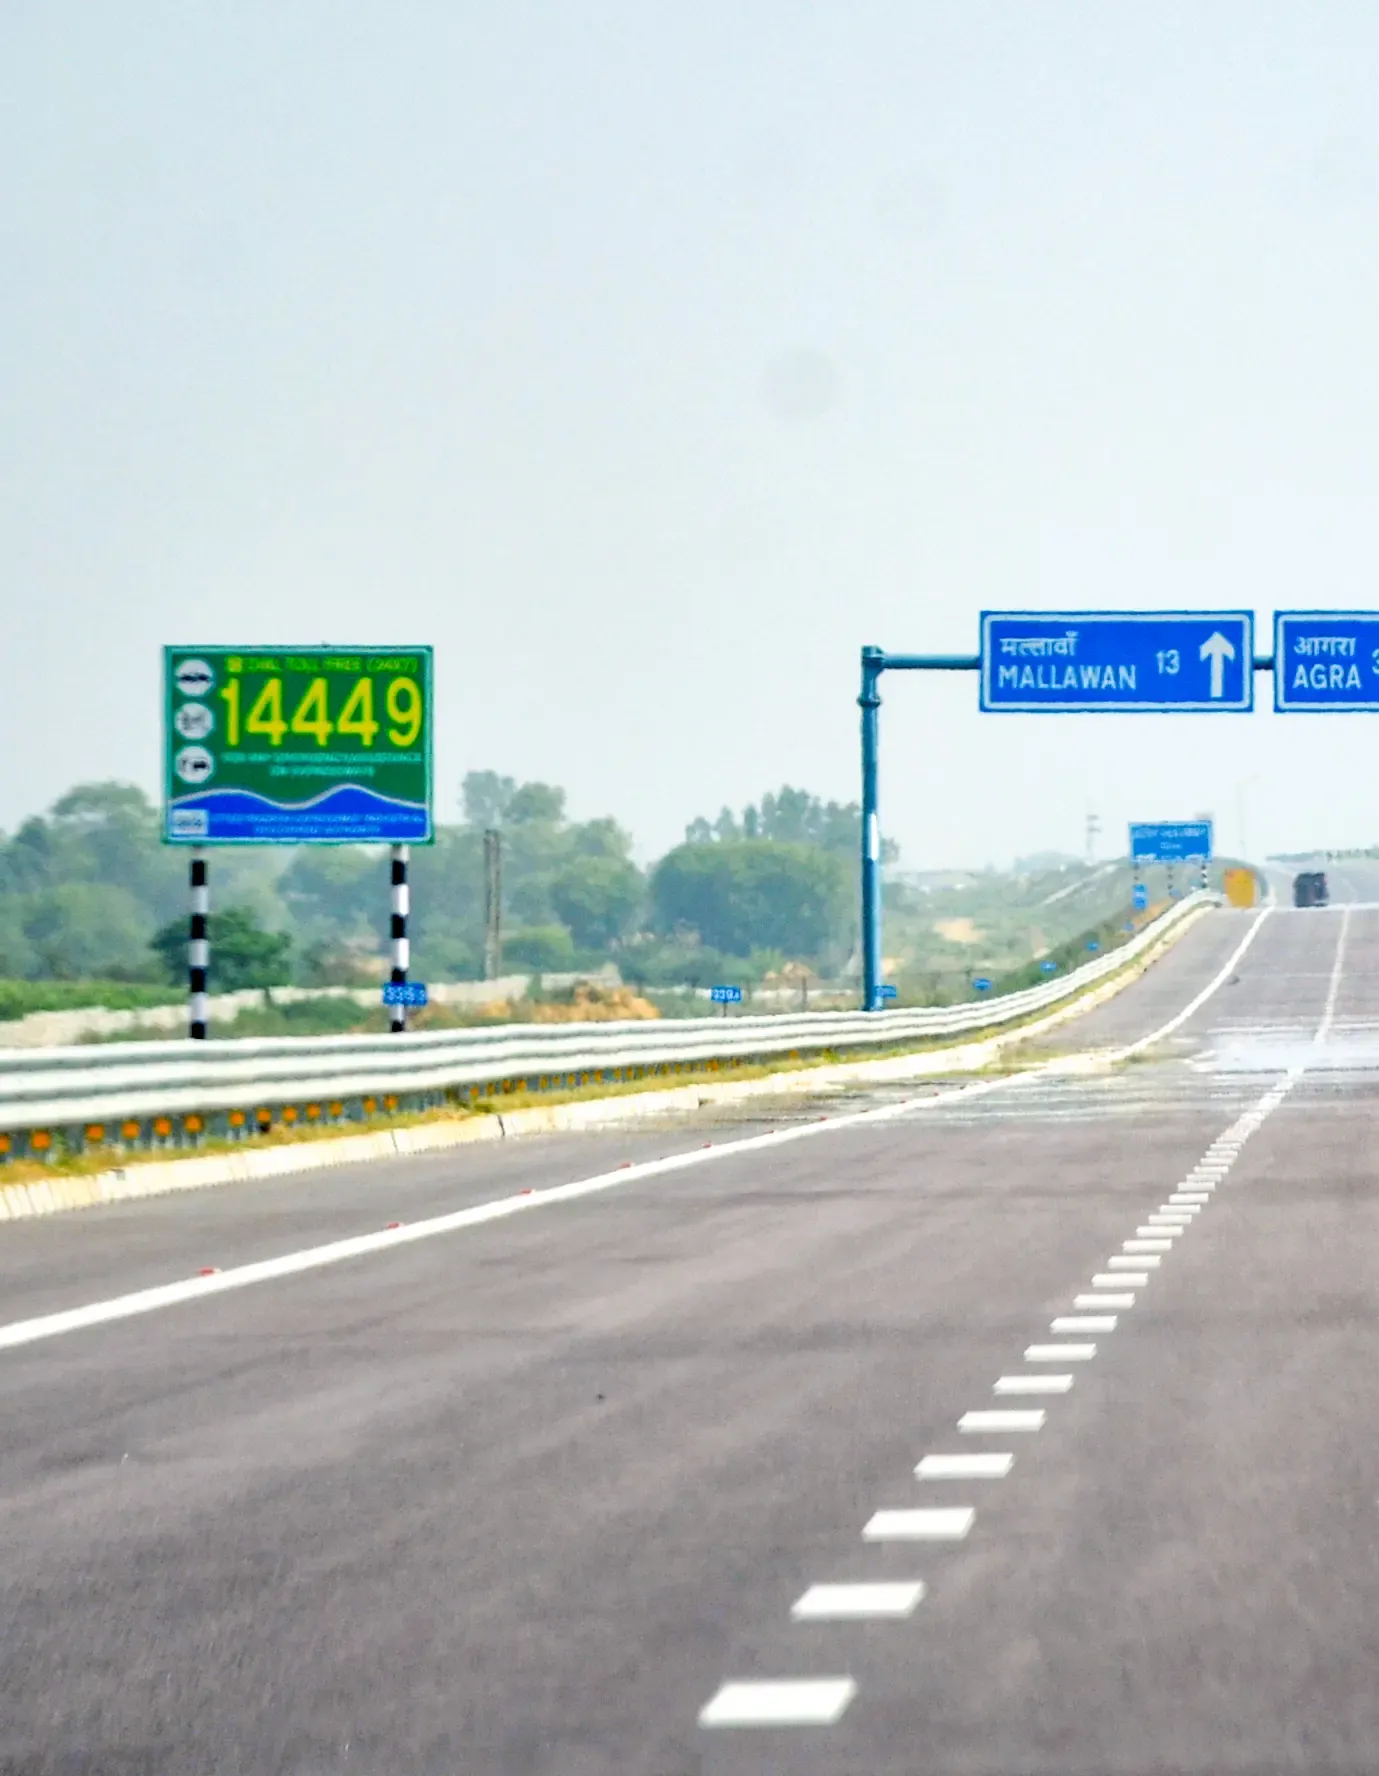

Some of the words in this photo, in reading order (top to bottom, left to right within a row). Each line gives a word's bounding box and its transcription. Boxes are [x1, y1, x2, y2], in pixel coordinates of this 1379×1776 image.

[1293, 636, 1357, 657] आगरा
[1156, 649, 1180, 676] 13
[998, 664, 1137, 691] MALLAWAN
[1291, 663, 1363, 690] AGRA
[217, 676, 423, 747] 14449
